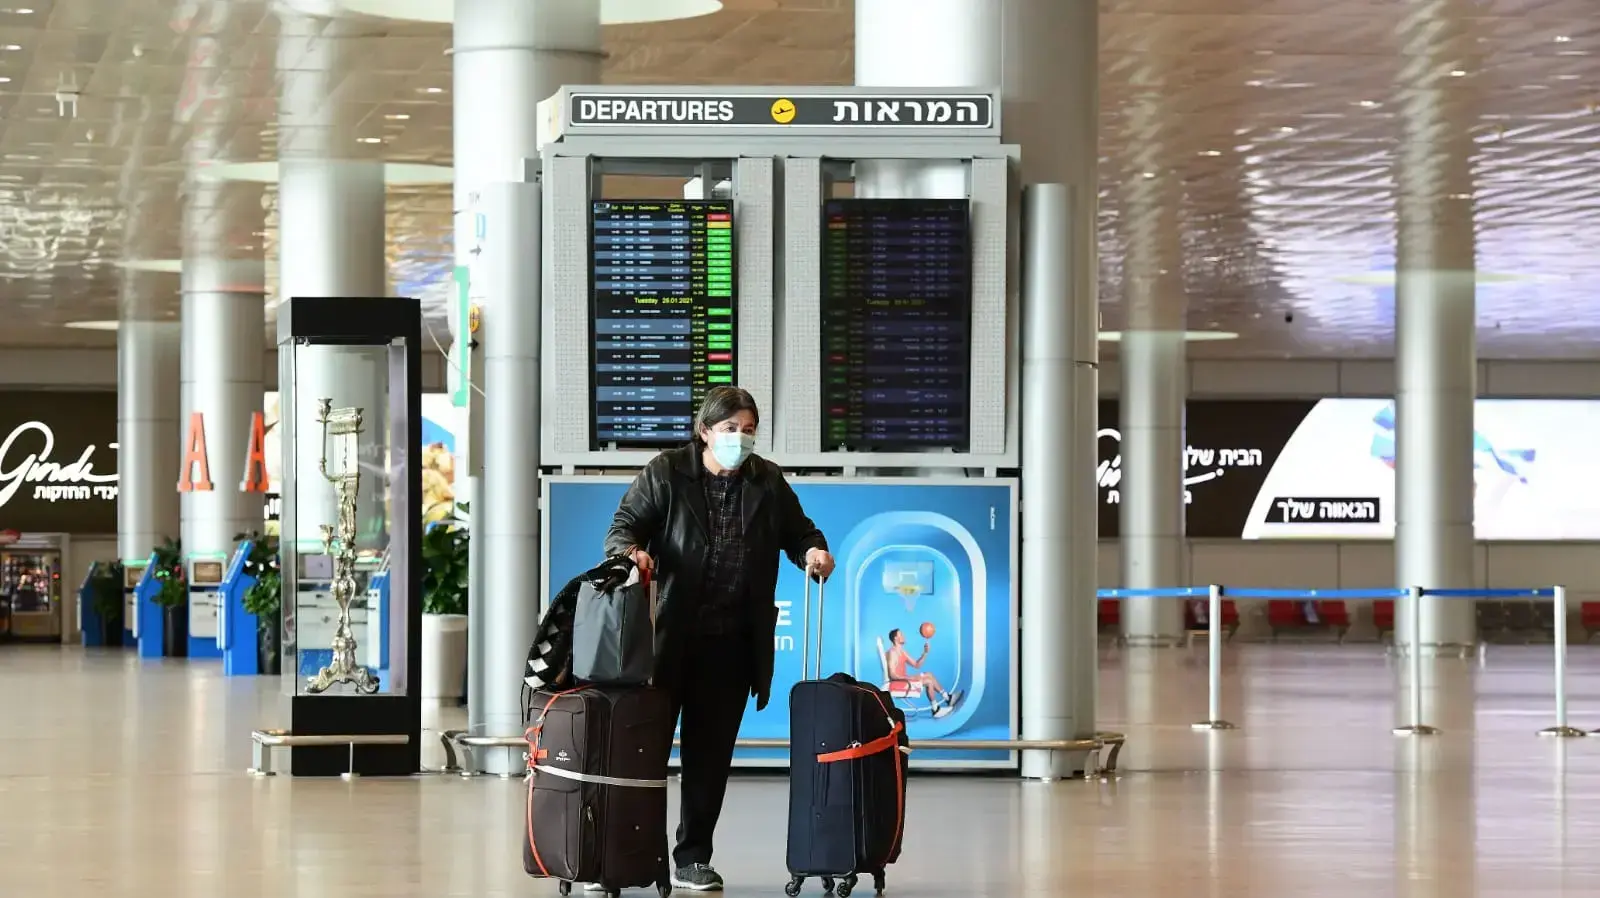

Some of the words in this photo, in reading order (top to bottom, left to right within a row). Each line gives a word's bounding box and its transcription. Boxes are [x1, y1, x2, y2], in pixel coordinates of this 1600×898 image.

[580, 99, 734, 121] DEPARTURES
[833, 101, 978, 122] המראות
[634, 297, 659, 305] Tuesday
[177, 412, 213, 492] A
[239, 411, 268, 492] A
[1218, 448, 1262, 466] הבית
[33, 486, 91, 502] החזקות
[1277, 498, 1315, 522] שלך
